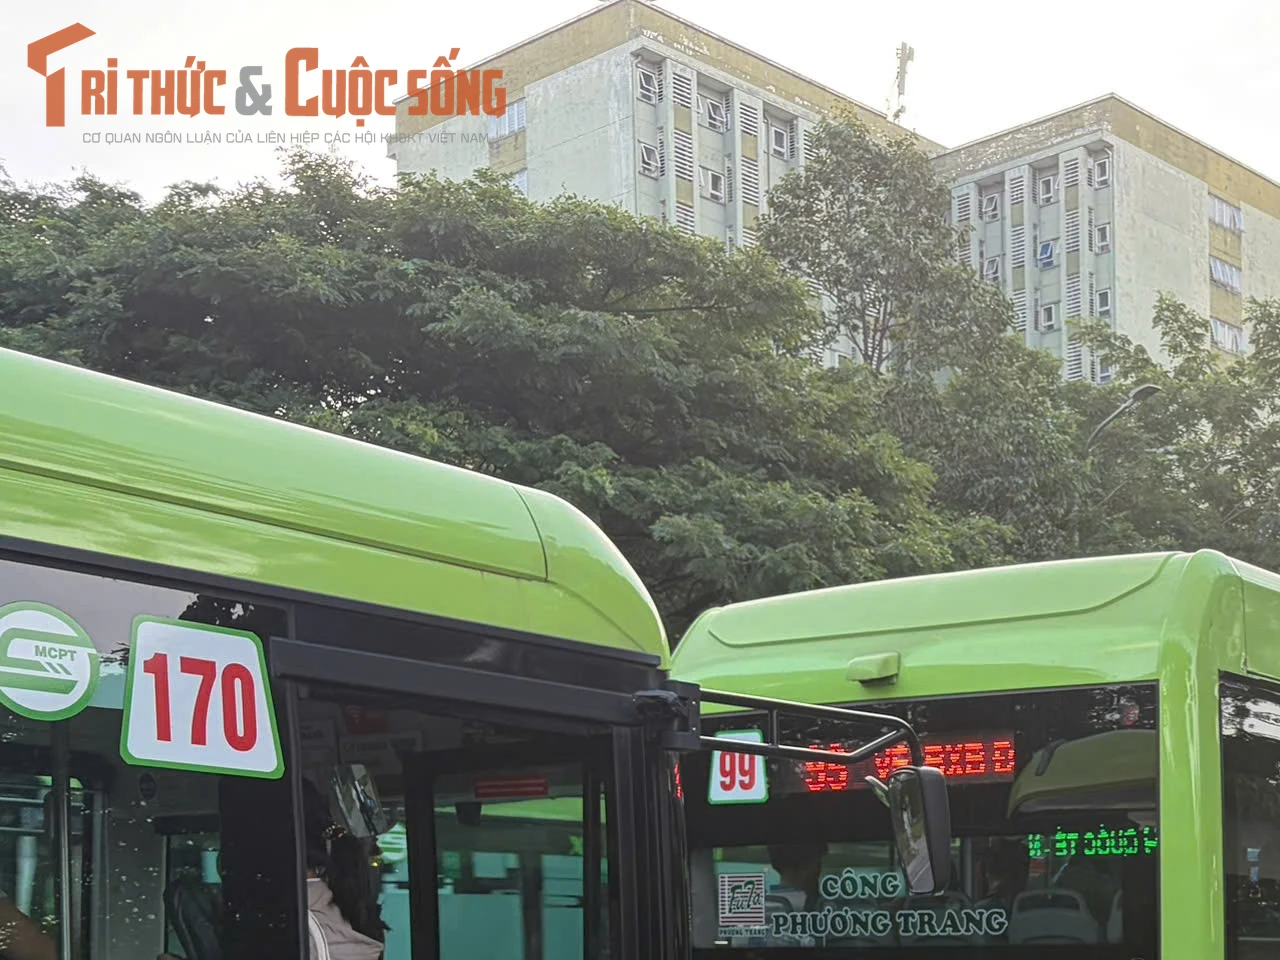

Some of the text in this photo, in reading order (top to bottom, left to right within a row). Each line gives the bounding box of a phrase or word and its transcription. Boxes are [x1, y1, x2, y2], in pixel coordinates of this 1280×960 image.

[34, 645, 77, 661] MCPT
[143, 652, 258, 752] 170
[719, 751, 756, 792] 99
[820, 867, 901, 900] CÔNG
[771, 906, 1009, 937] PHƯƠNG TRANG
